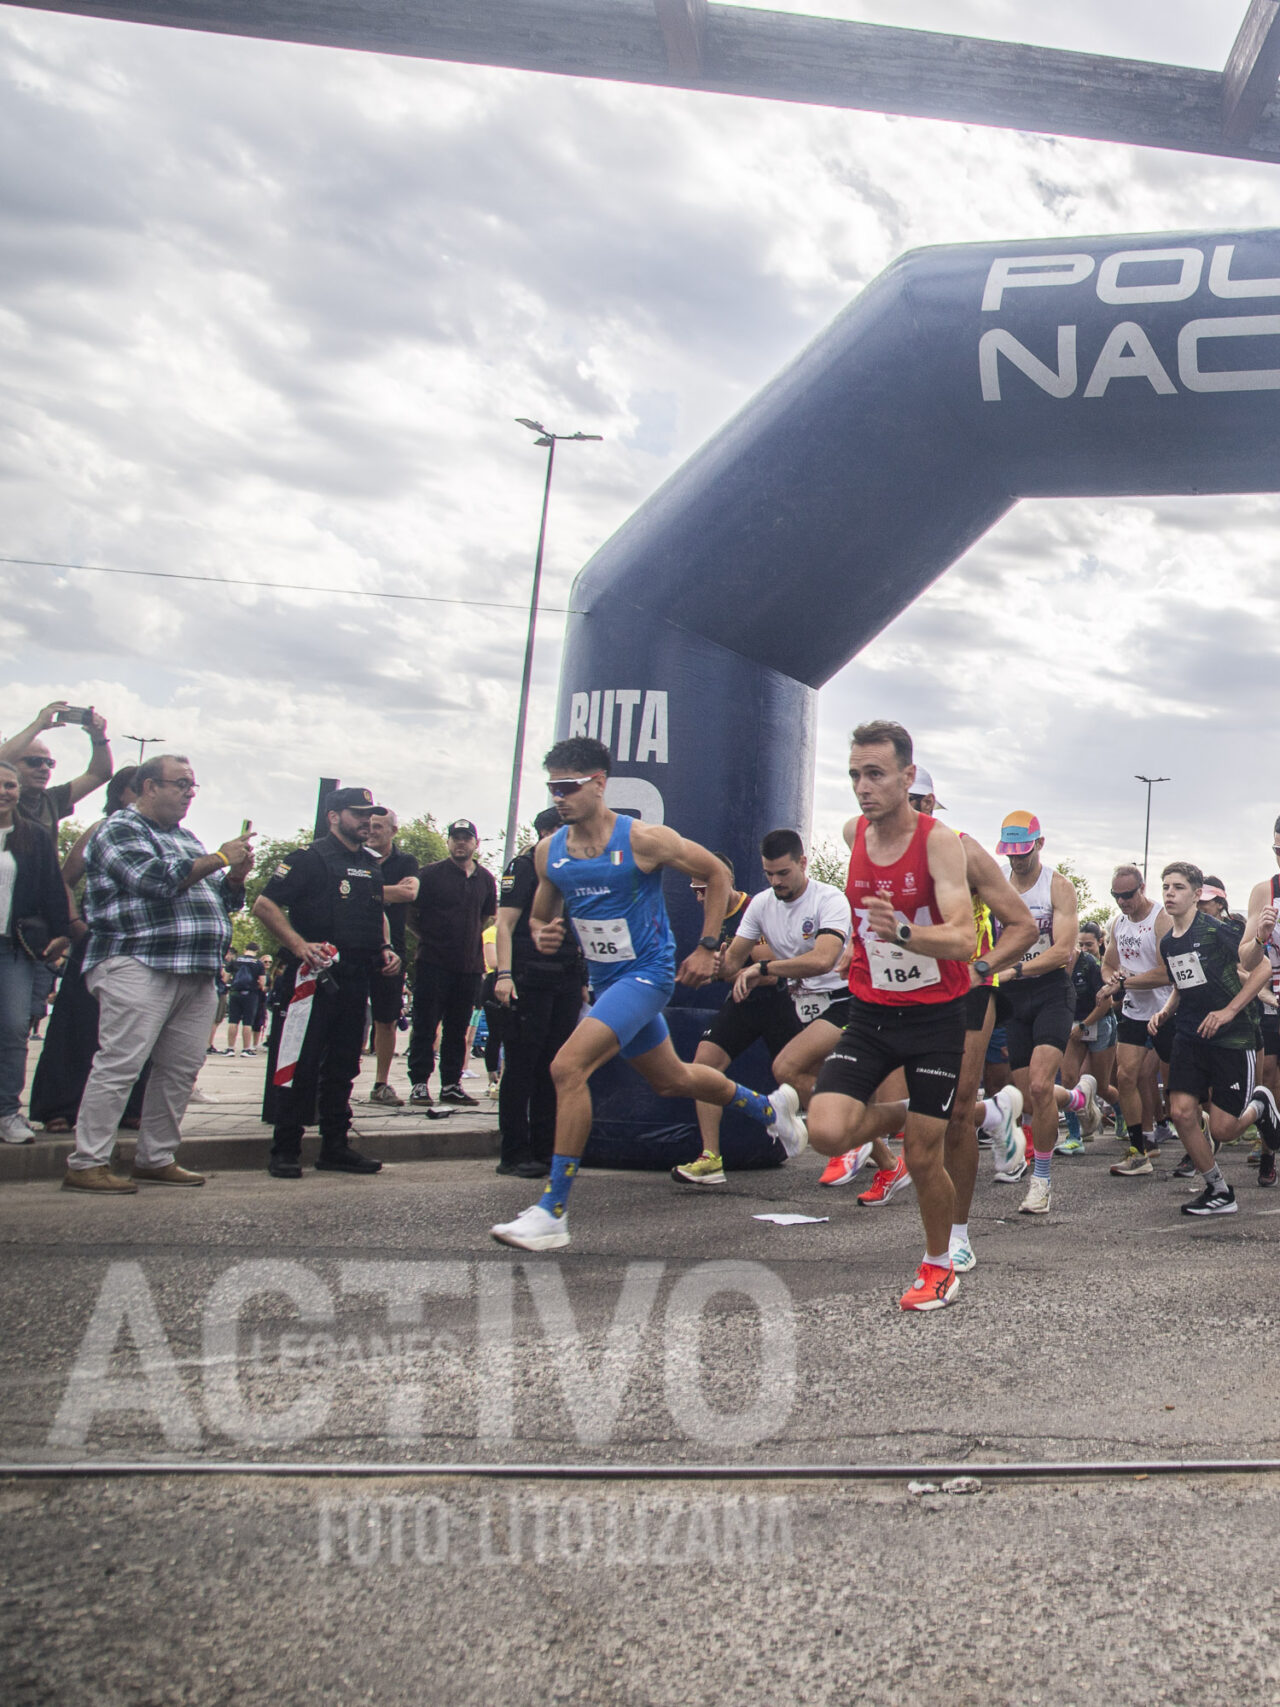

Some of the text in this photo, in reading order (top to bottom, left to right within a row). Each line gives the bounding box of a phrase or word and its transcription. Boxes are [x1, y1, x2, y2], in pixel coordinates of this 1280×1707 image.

[568, 689, 669, 764] RUTA
[574, 886, 611, 897] ITALIA
[589, 941, 618, 955] 126
[883, 965, 922, 982] 184
